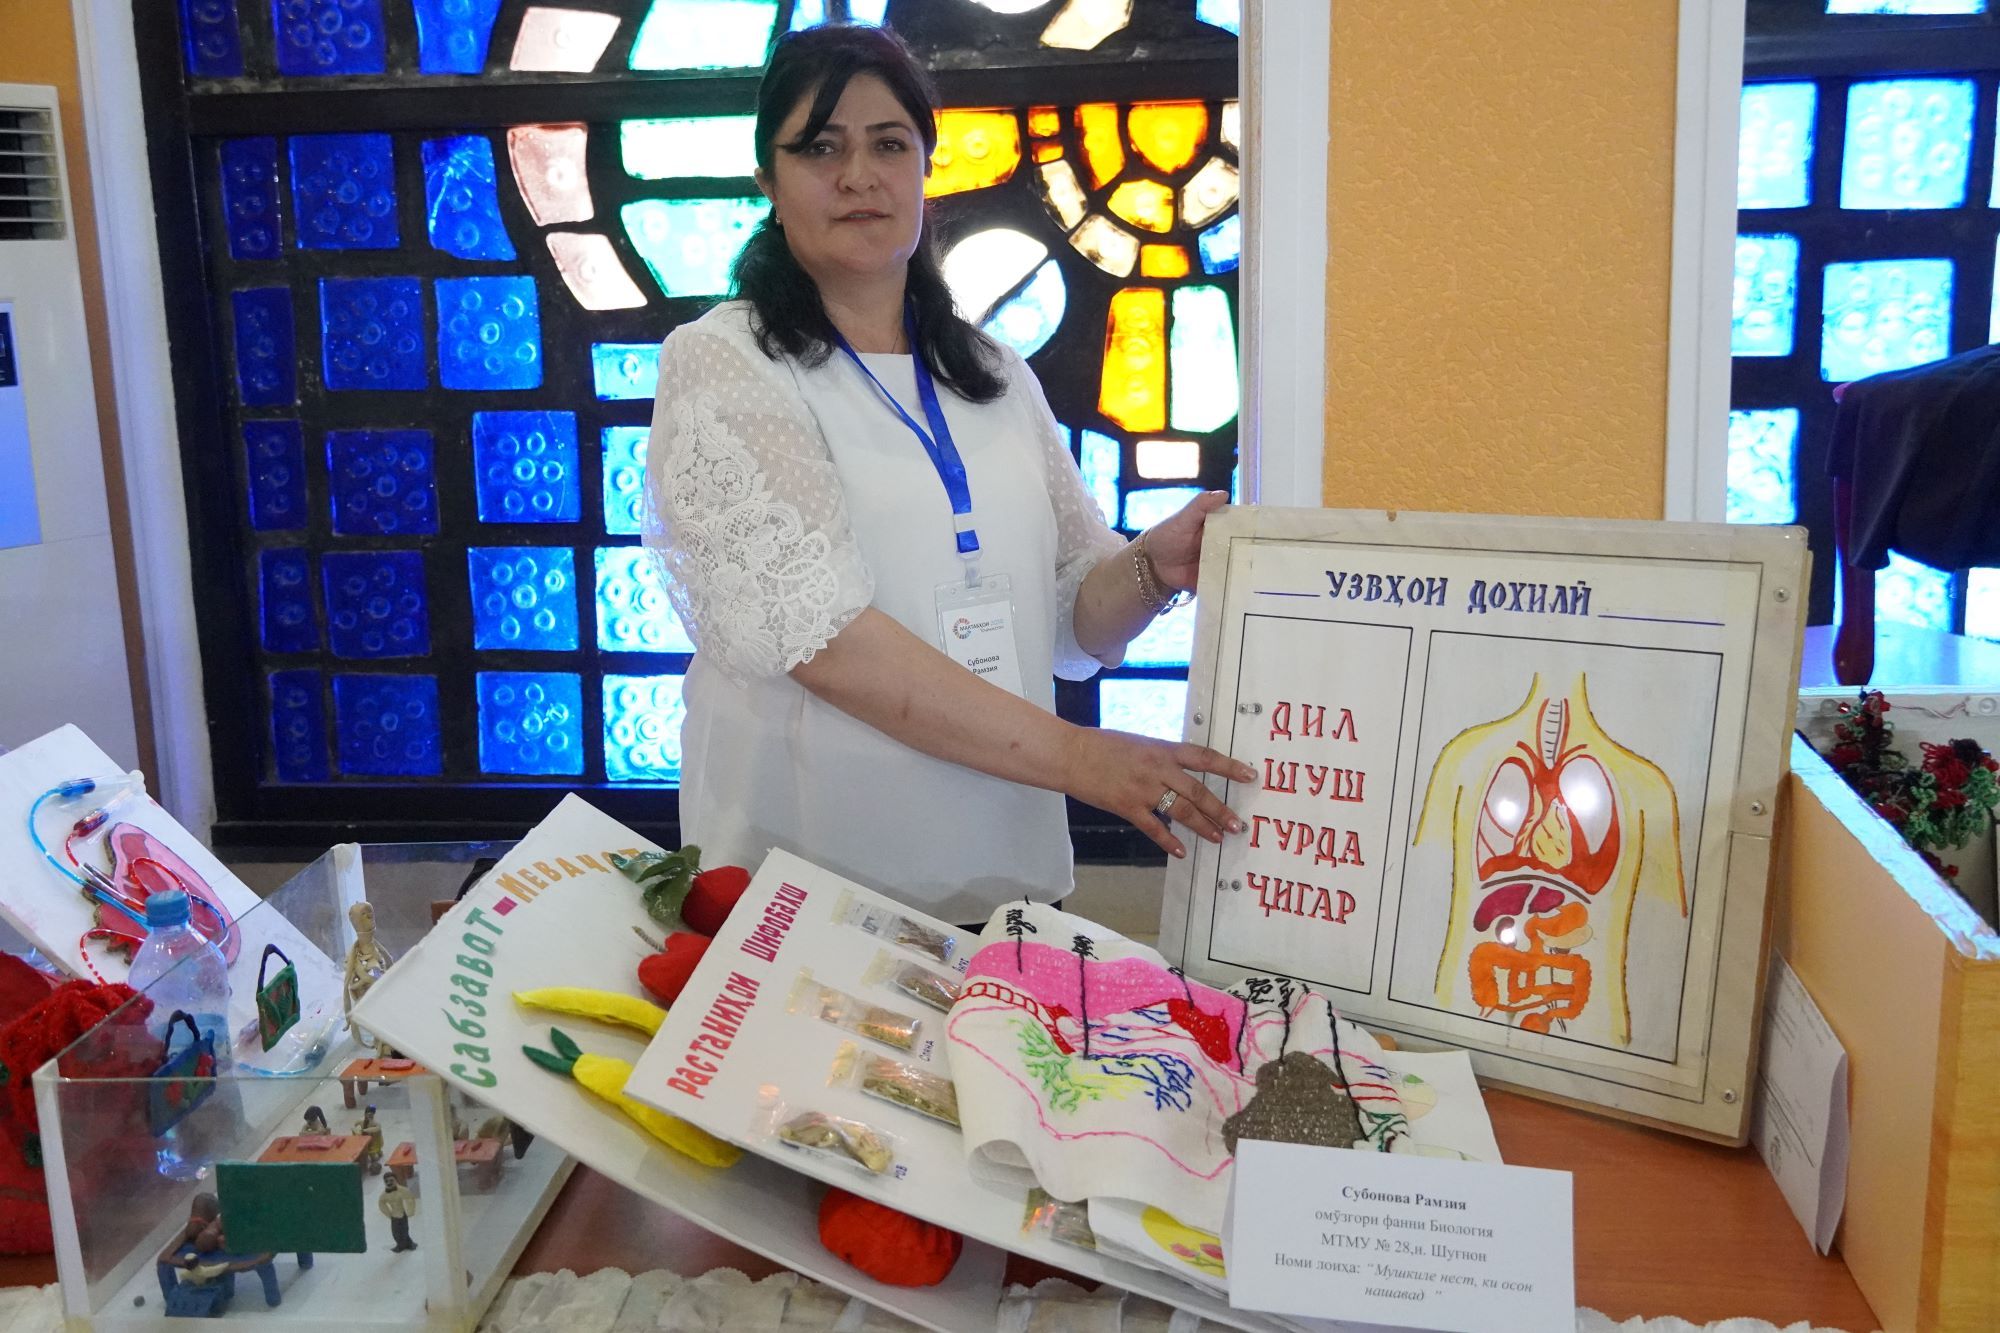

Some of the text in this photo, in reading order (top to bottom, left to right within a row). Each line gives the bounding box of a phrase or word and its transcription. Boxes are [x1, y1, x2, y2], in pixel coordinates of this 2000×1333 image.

[1325, 570, 1591, 616] УЗВҲОИ ДОХИЛӢ
[967, 655, 1000, 666] Субонова
[973, 666, 998, 674] Рамзия
[1269, 701, 1358, 742] ДИЛ
[1262, 758, 1365, 803] ШУШ
[1249, 814, 1365, 868] ГУРДА
[1246, 871, 1356, 924] ҶИГАР
[1342, 1186, 1467, 1210] Субонова Рамзия
[1321, 1233, 1370, 1249] МТМУ
[1382, 1214, 1425, 1230] фанни
[1430, 1219, 1493, 1238] Биология
[1274, 1253, 1312, 1269] Номи
[1440, 1273, 1478, 1288] нест,
[1482, 1279, 1498, 1289] ки
[1501, 1282, 1534, 1293] осон
[1364, 1287, 1425, 1302] нашавад
